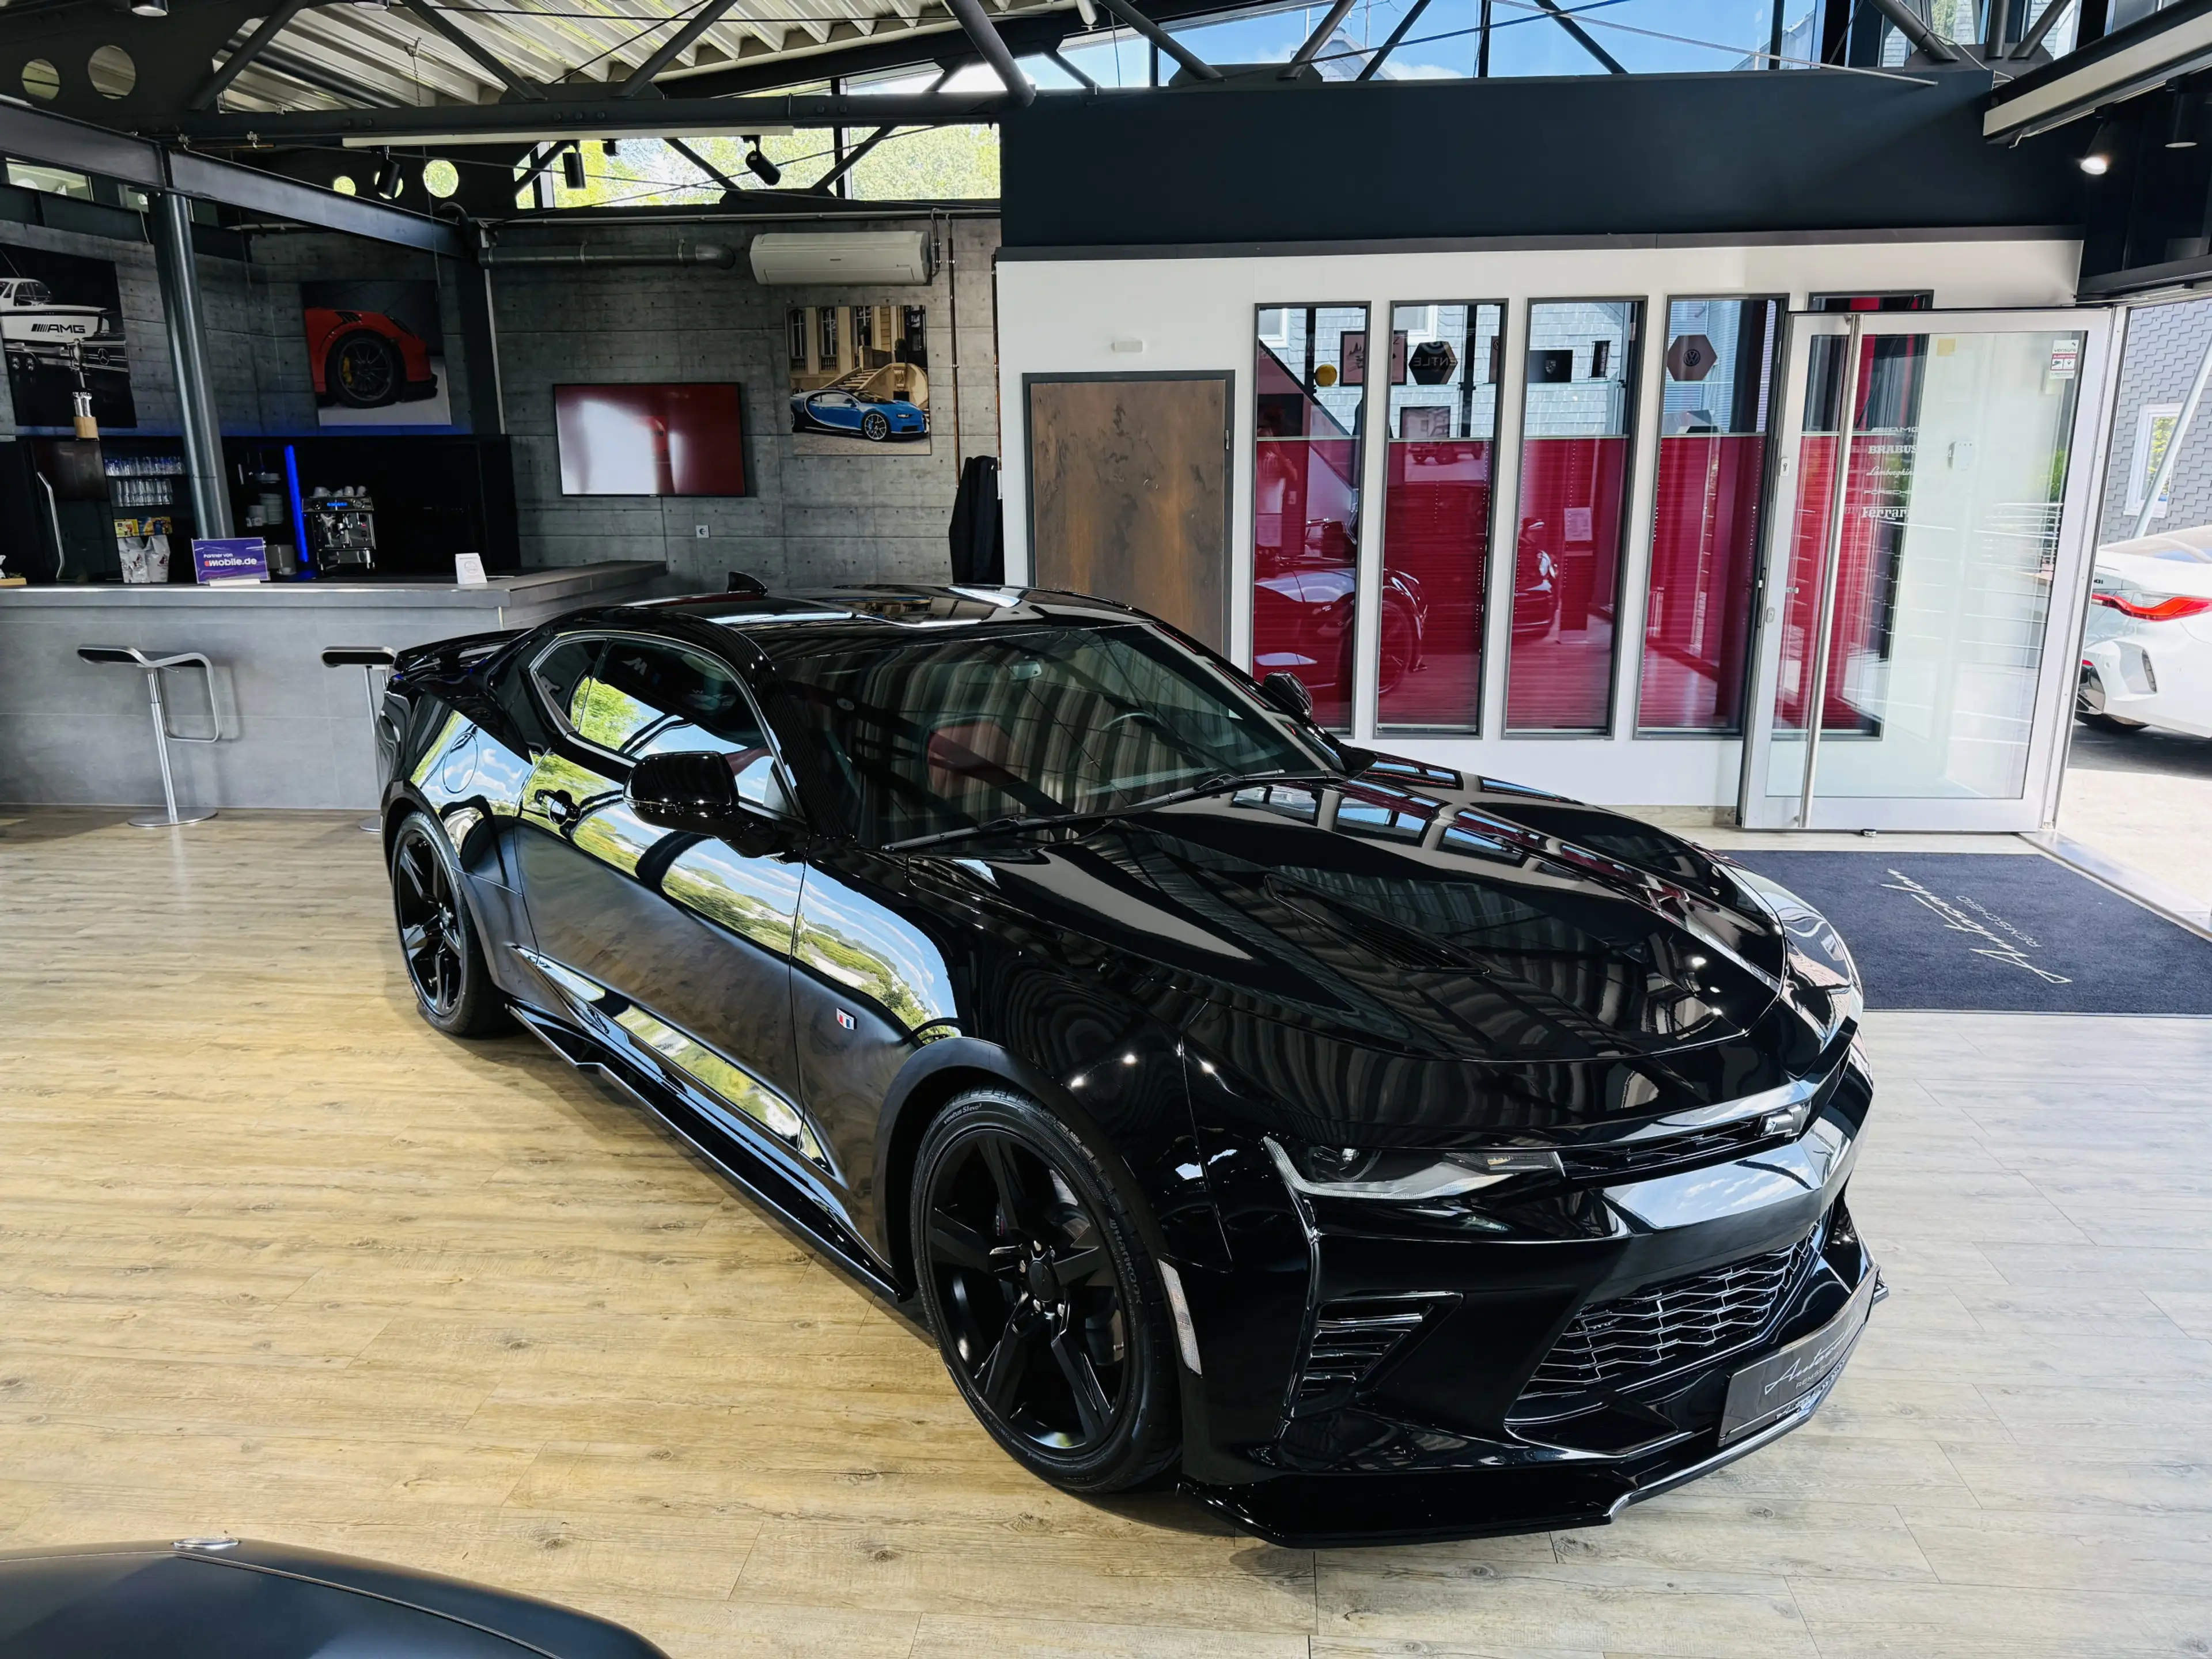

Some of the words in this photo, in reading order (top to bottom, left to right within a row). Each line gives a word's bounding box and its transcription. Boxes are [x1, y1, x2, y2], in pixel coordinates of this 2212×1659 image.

[47, 324, 86, 334] AMG
[1868, 445, 1918, 454] BRABUS
[209, 558, 257, 567] mobile.de
